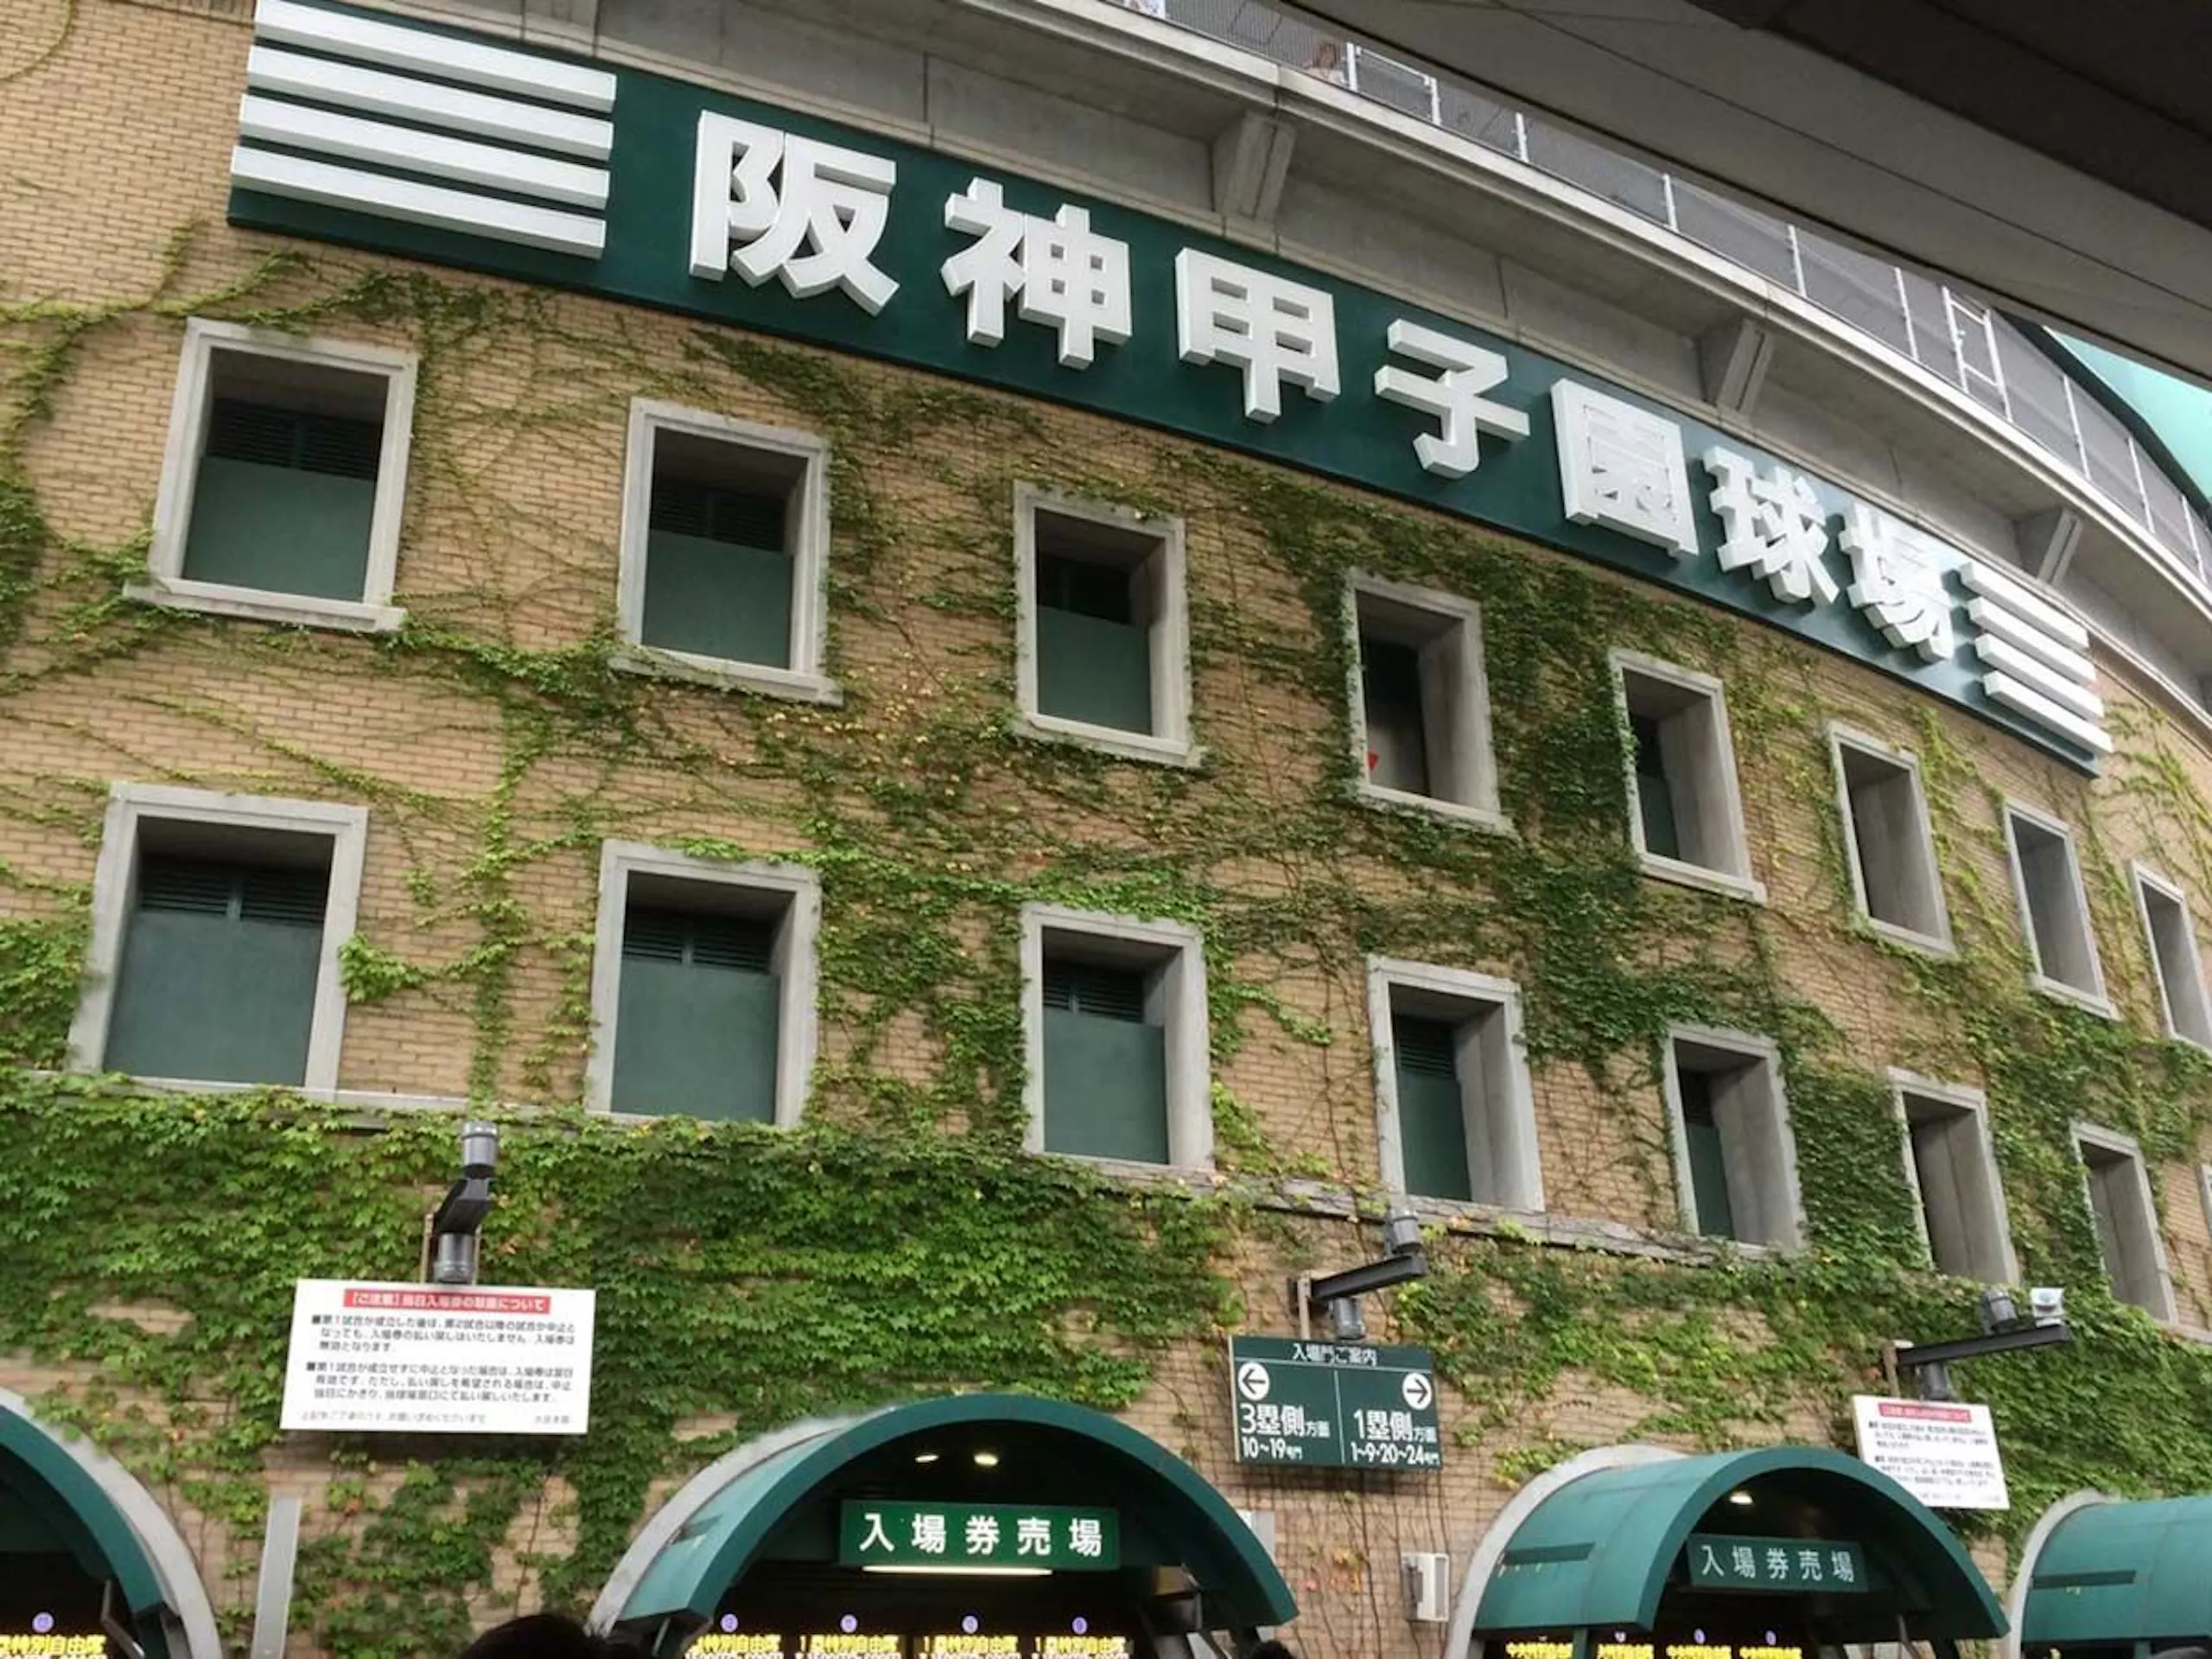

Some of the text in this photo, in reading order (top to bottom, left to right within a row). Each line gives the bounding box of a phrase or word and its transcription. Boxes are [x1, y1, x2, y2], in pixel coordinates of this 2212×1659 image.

[690, 110, 1961, 664] 阪神甲子園球場
[1292, 1343, 1377, 1366] 入場門ご案内
[1240, 1402, 1331, 1438] 3塁側方面
[1353, 1408, 1438, 1443] 1塁側方面
[860, 1513, 1103, 1557] 入場券売場
[1701, 1543, 1855, 1583] 入場券売場
